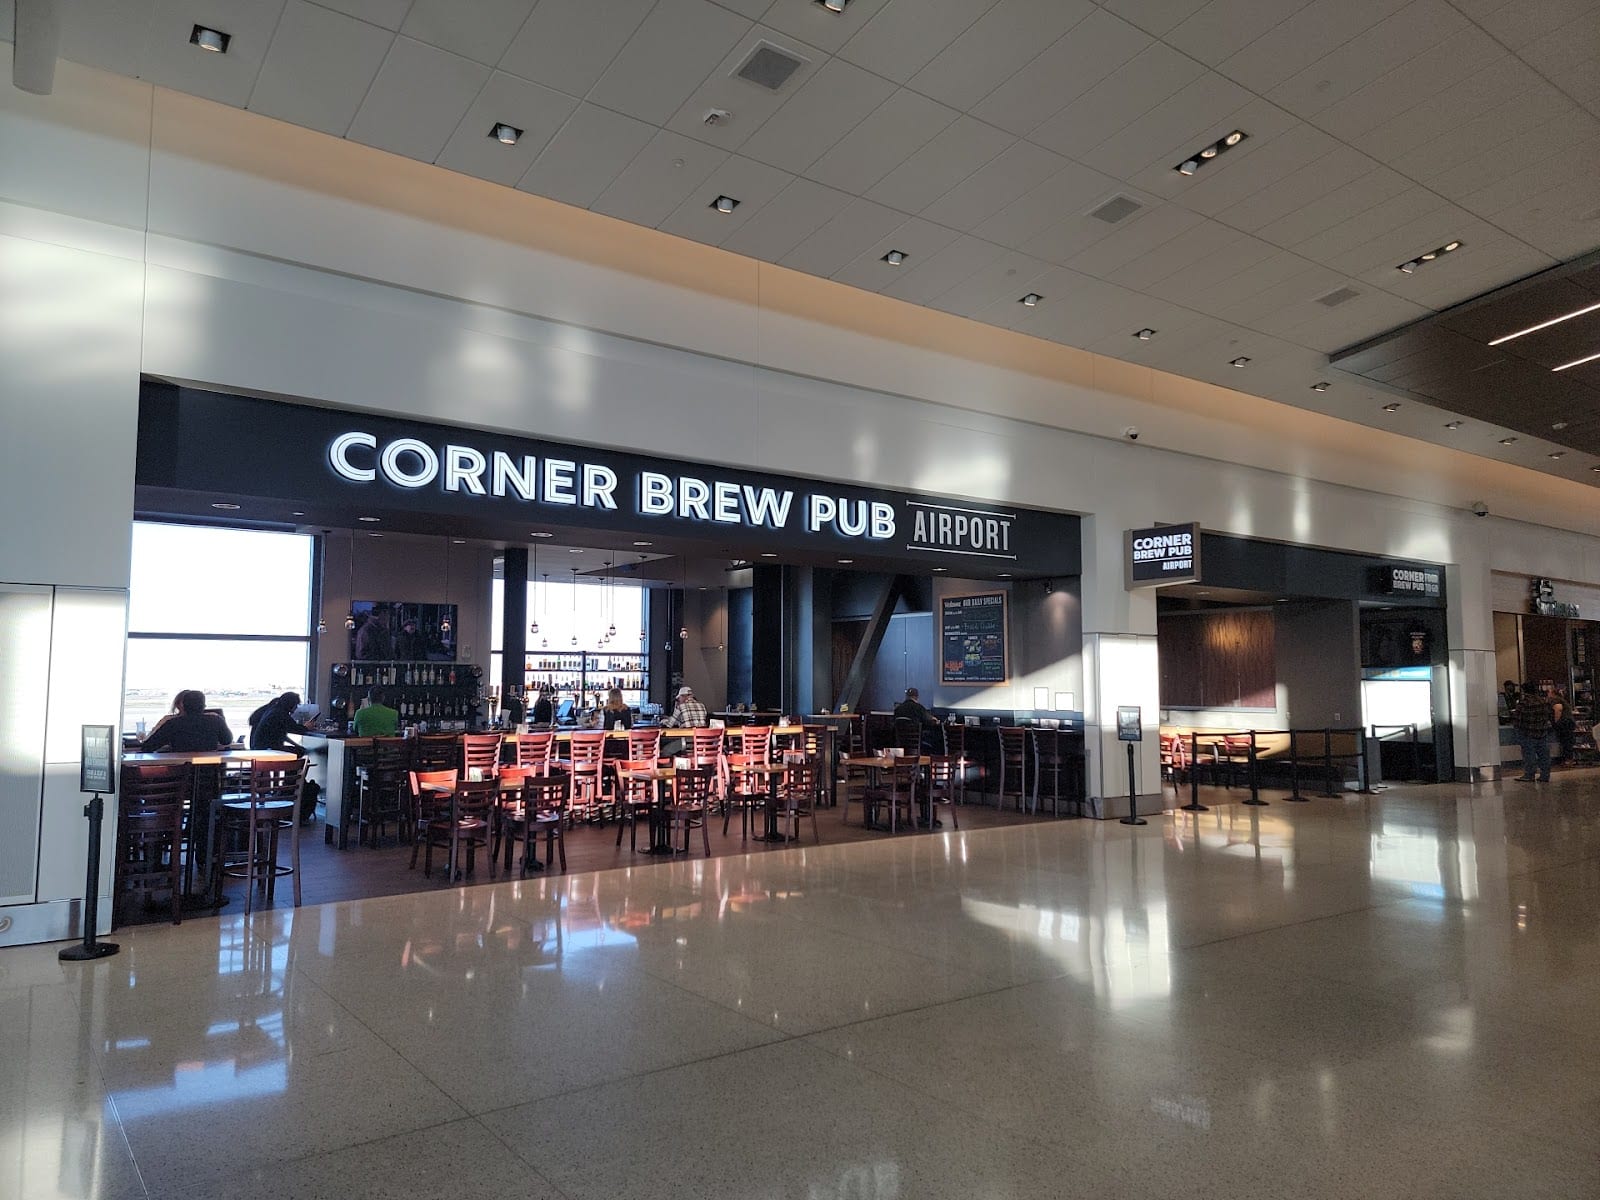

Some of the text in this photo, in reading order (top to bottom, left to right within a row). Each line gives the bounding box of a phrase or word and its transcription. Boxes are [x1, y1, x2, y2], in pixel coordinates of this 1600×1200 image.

[328, 430, 897, 540] CORNER BREW PUB
[913, 509, 1011, 551] AIRPORT
[1134, 534, 1192, 550] CORNER
[1134, 545, 1192, 560] BREW PUB
[1163, 560, 1192, 570] AIRPORT
[1393, 569, 1424, 582] CORNER
[1393, 580, 1411, 590] BREW
[1412, 582, 1425, 591] PUB
[983, 596, 1002, 605] SPECIALS
